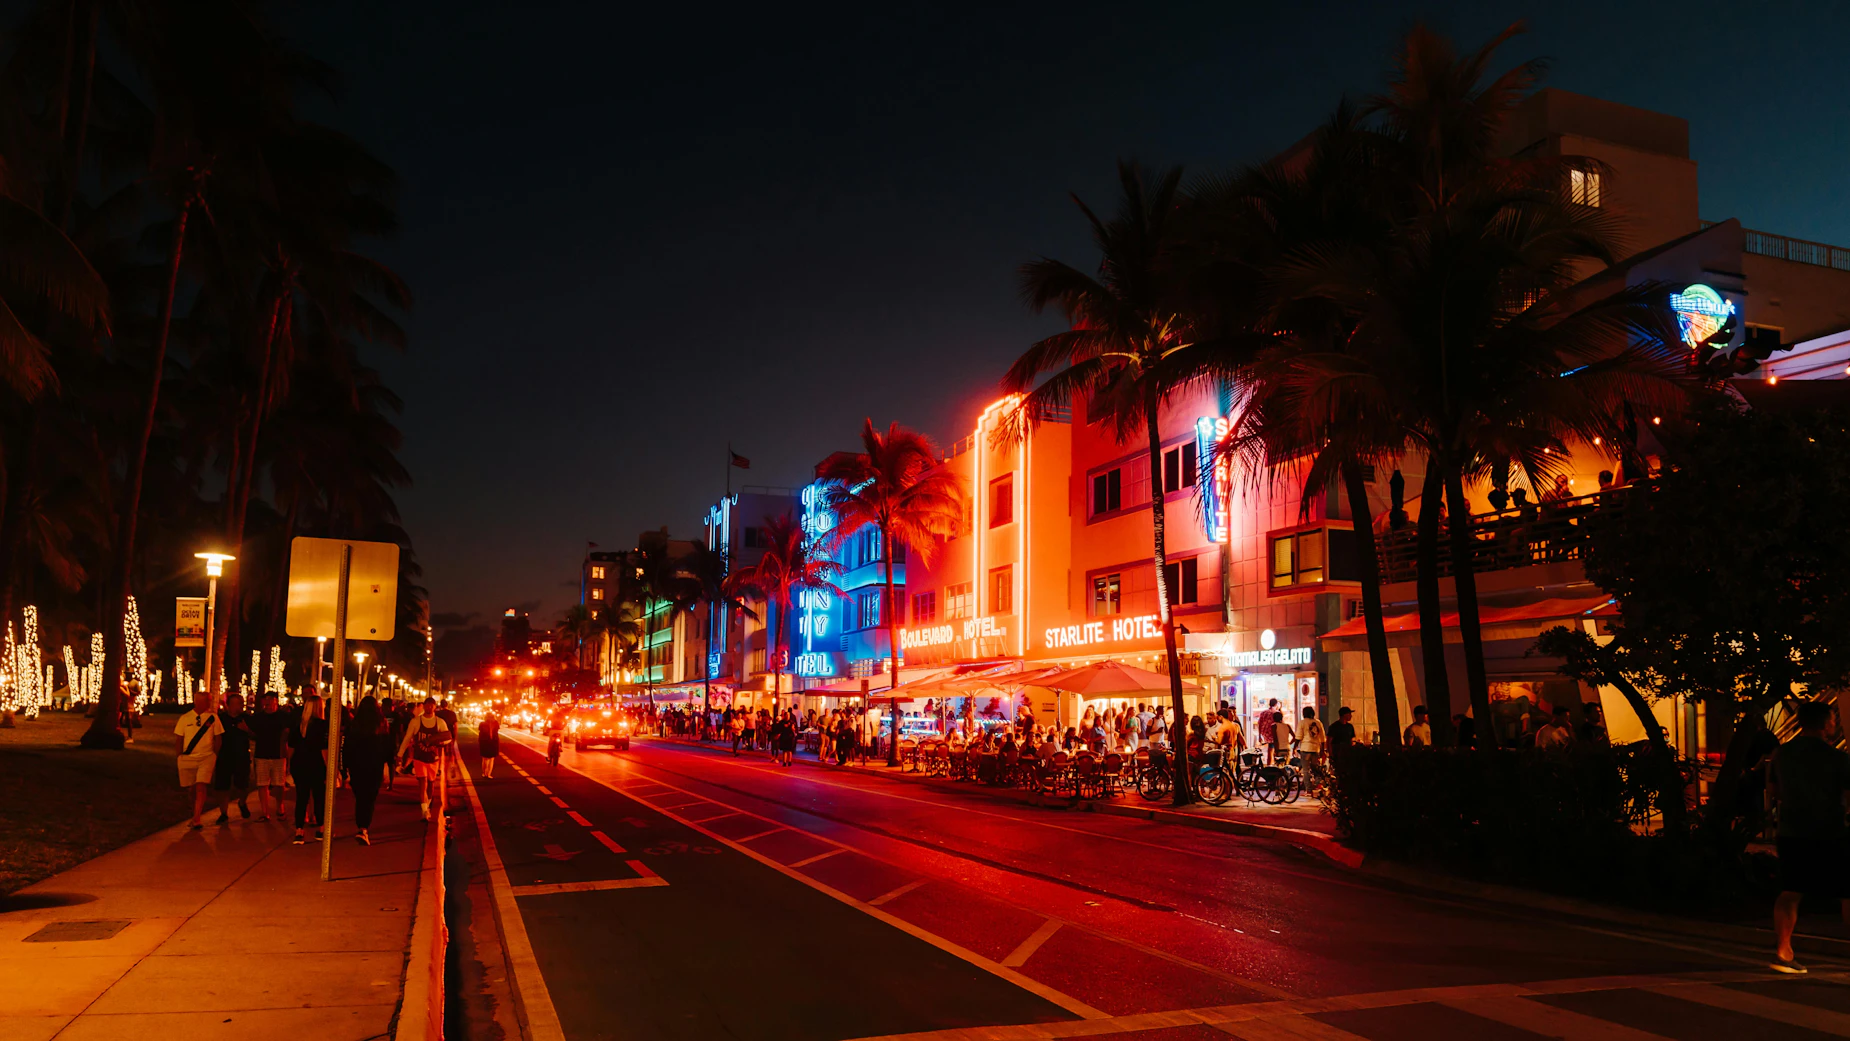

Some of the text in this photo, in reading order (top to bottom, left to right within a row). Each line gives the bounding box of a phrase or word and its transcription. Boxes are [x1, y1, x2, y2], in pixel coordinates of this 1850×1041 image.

[1215, 418, 1229, 542] SARLITE
[900, 616, 1001, 649] BOULEVARD HOTEL
[1045, 614, 1162, 648] STARLITE HOTEL
[1275, 647, 1311, 665] GELATO
